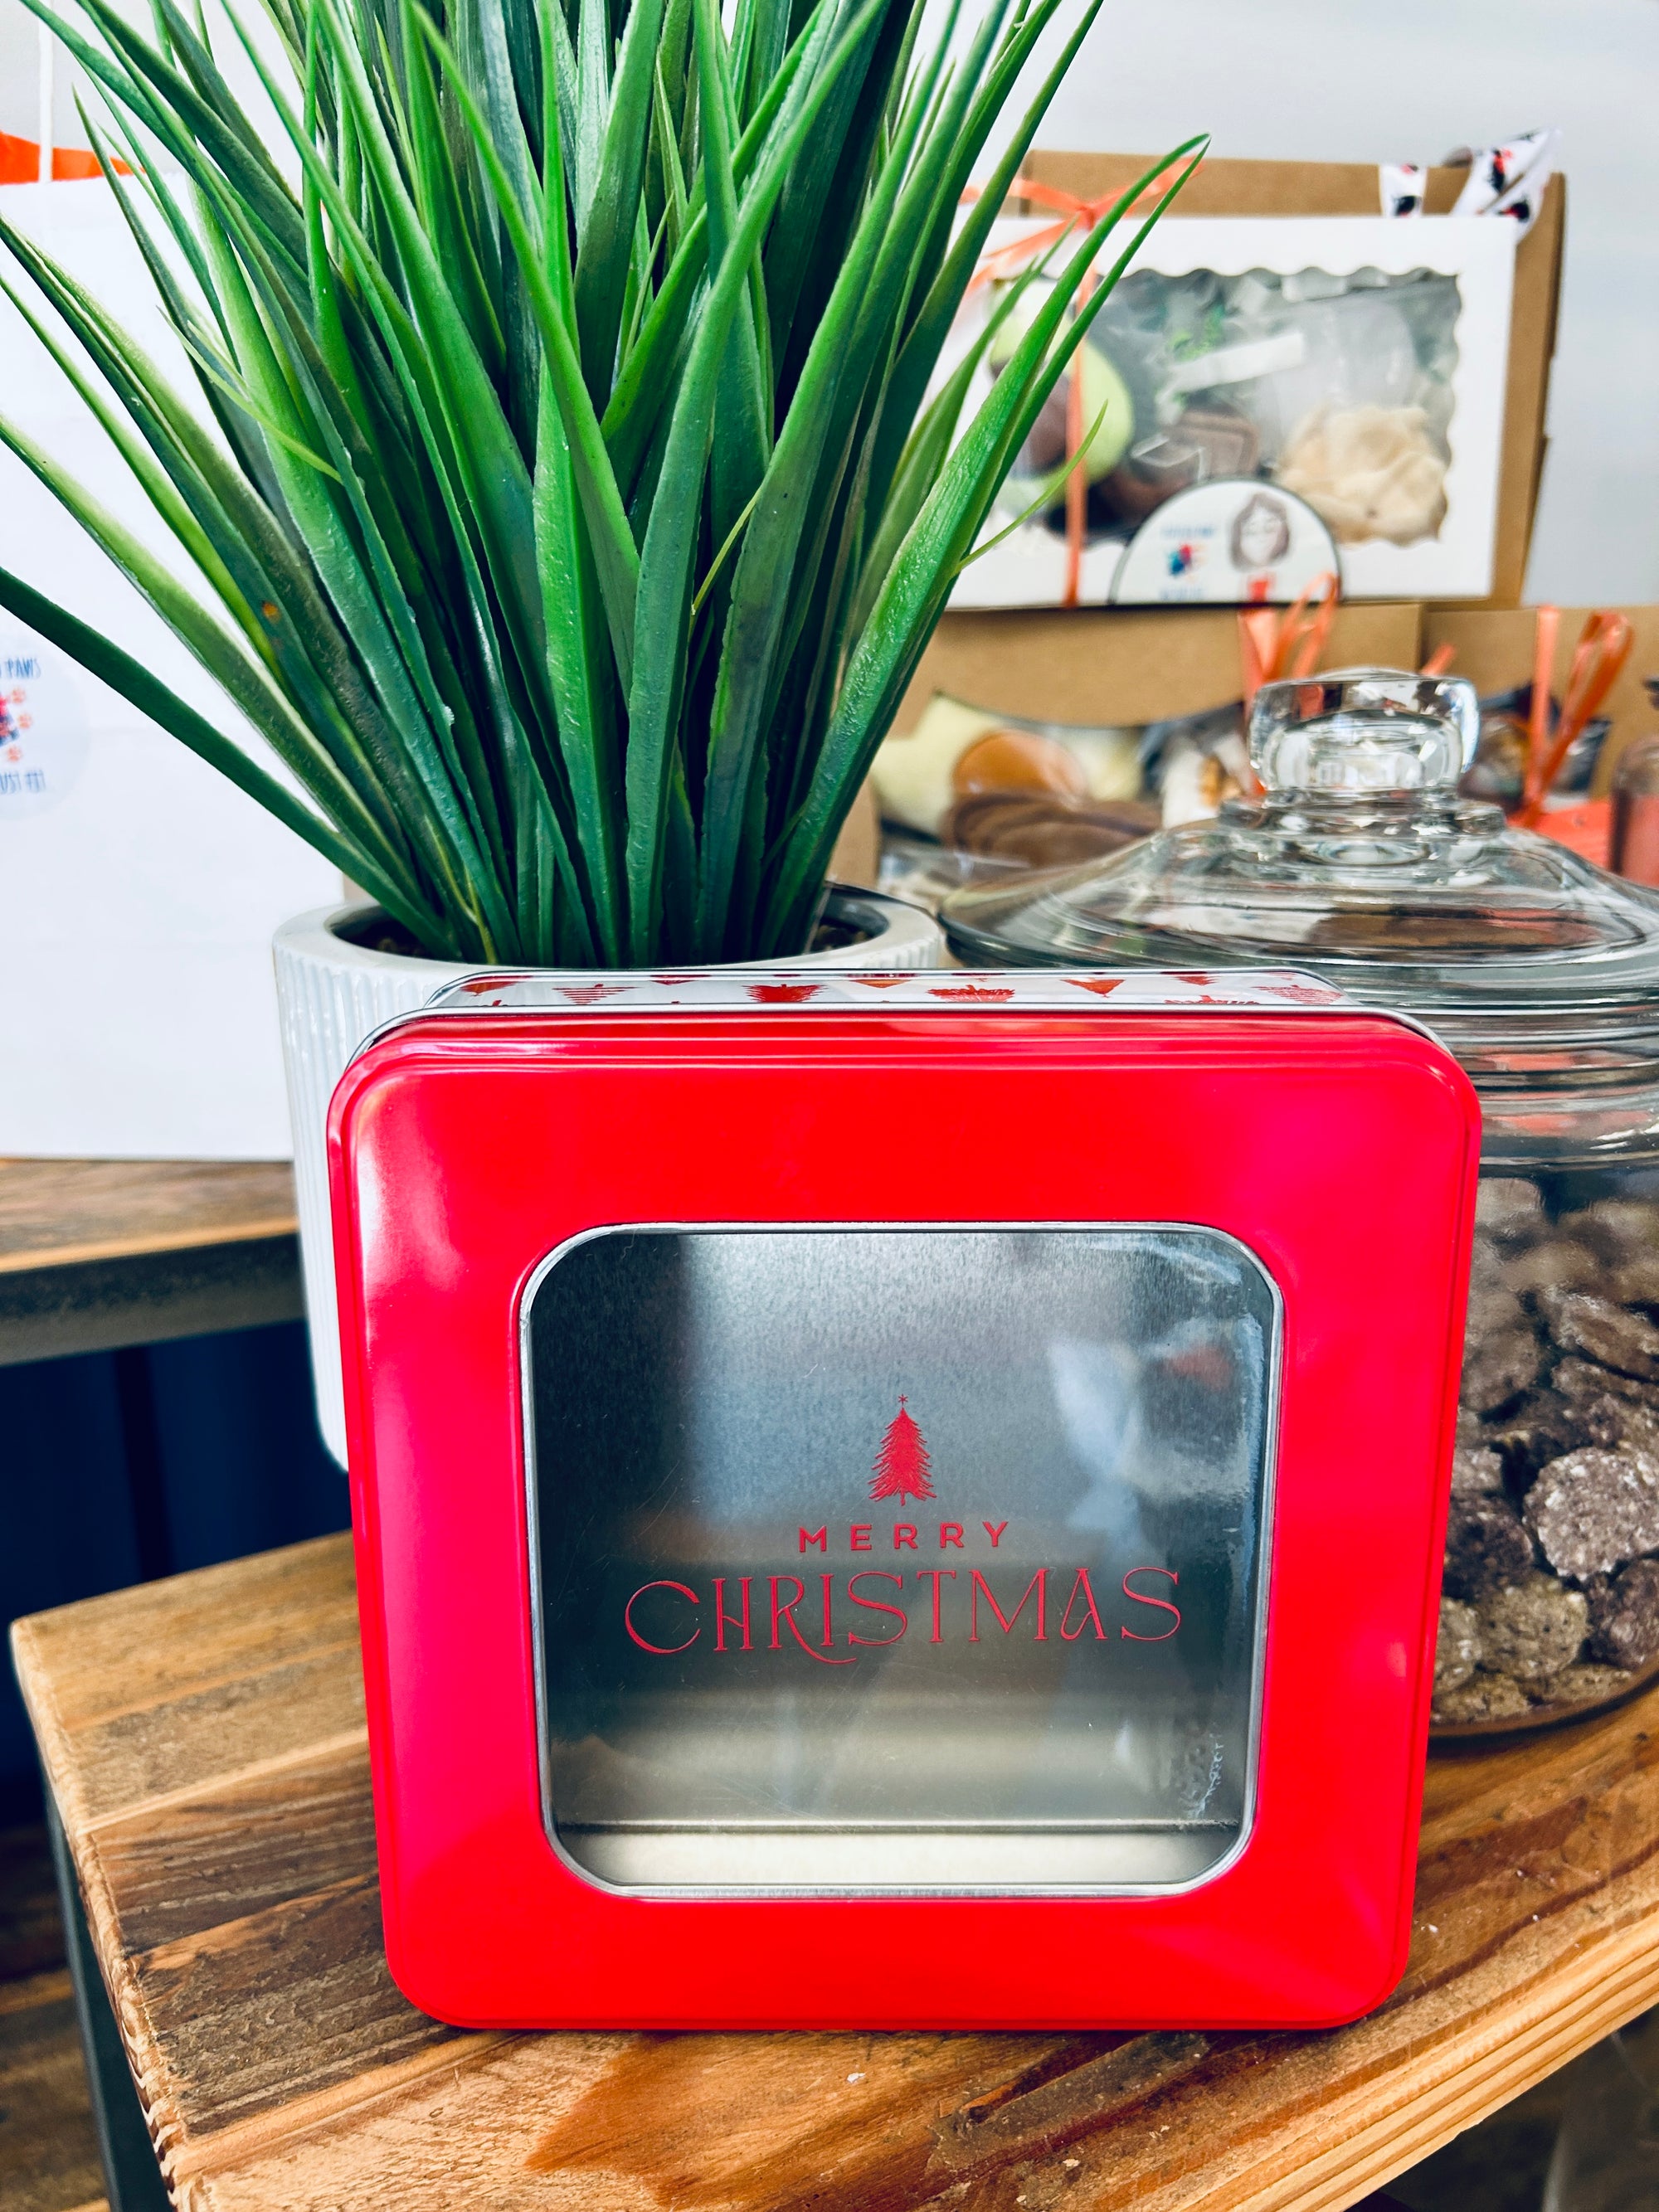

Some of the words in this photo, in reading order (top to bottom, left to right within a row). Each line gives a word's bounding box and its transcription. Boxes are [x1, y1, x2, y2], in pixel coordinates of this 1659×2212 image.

[6, 657, 41, 678] PAWS
[798, 1521, 1009, 1553] MERRY
[625, 1567, 1181, 1665] CHRISTMAS
